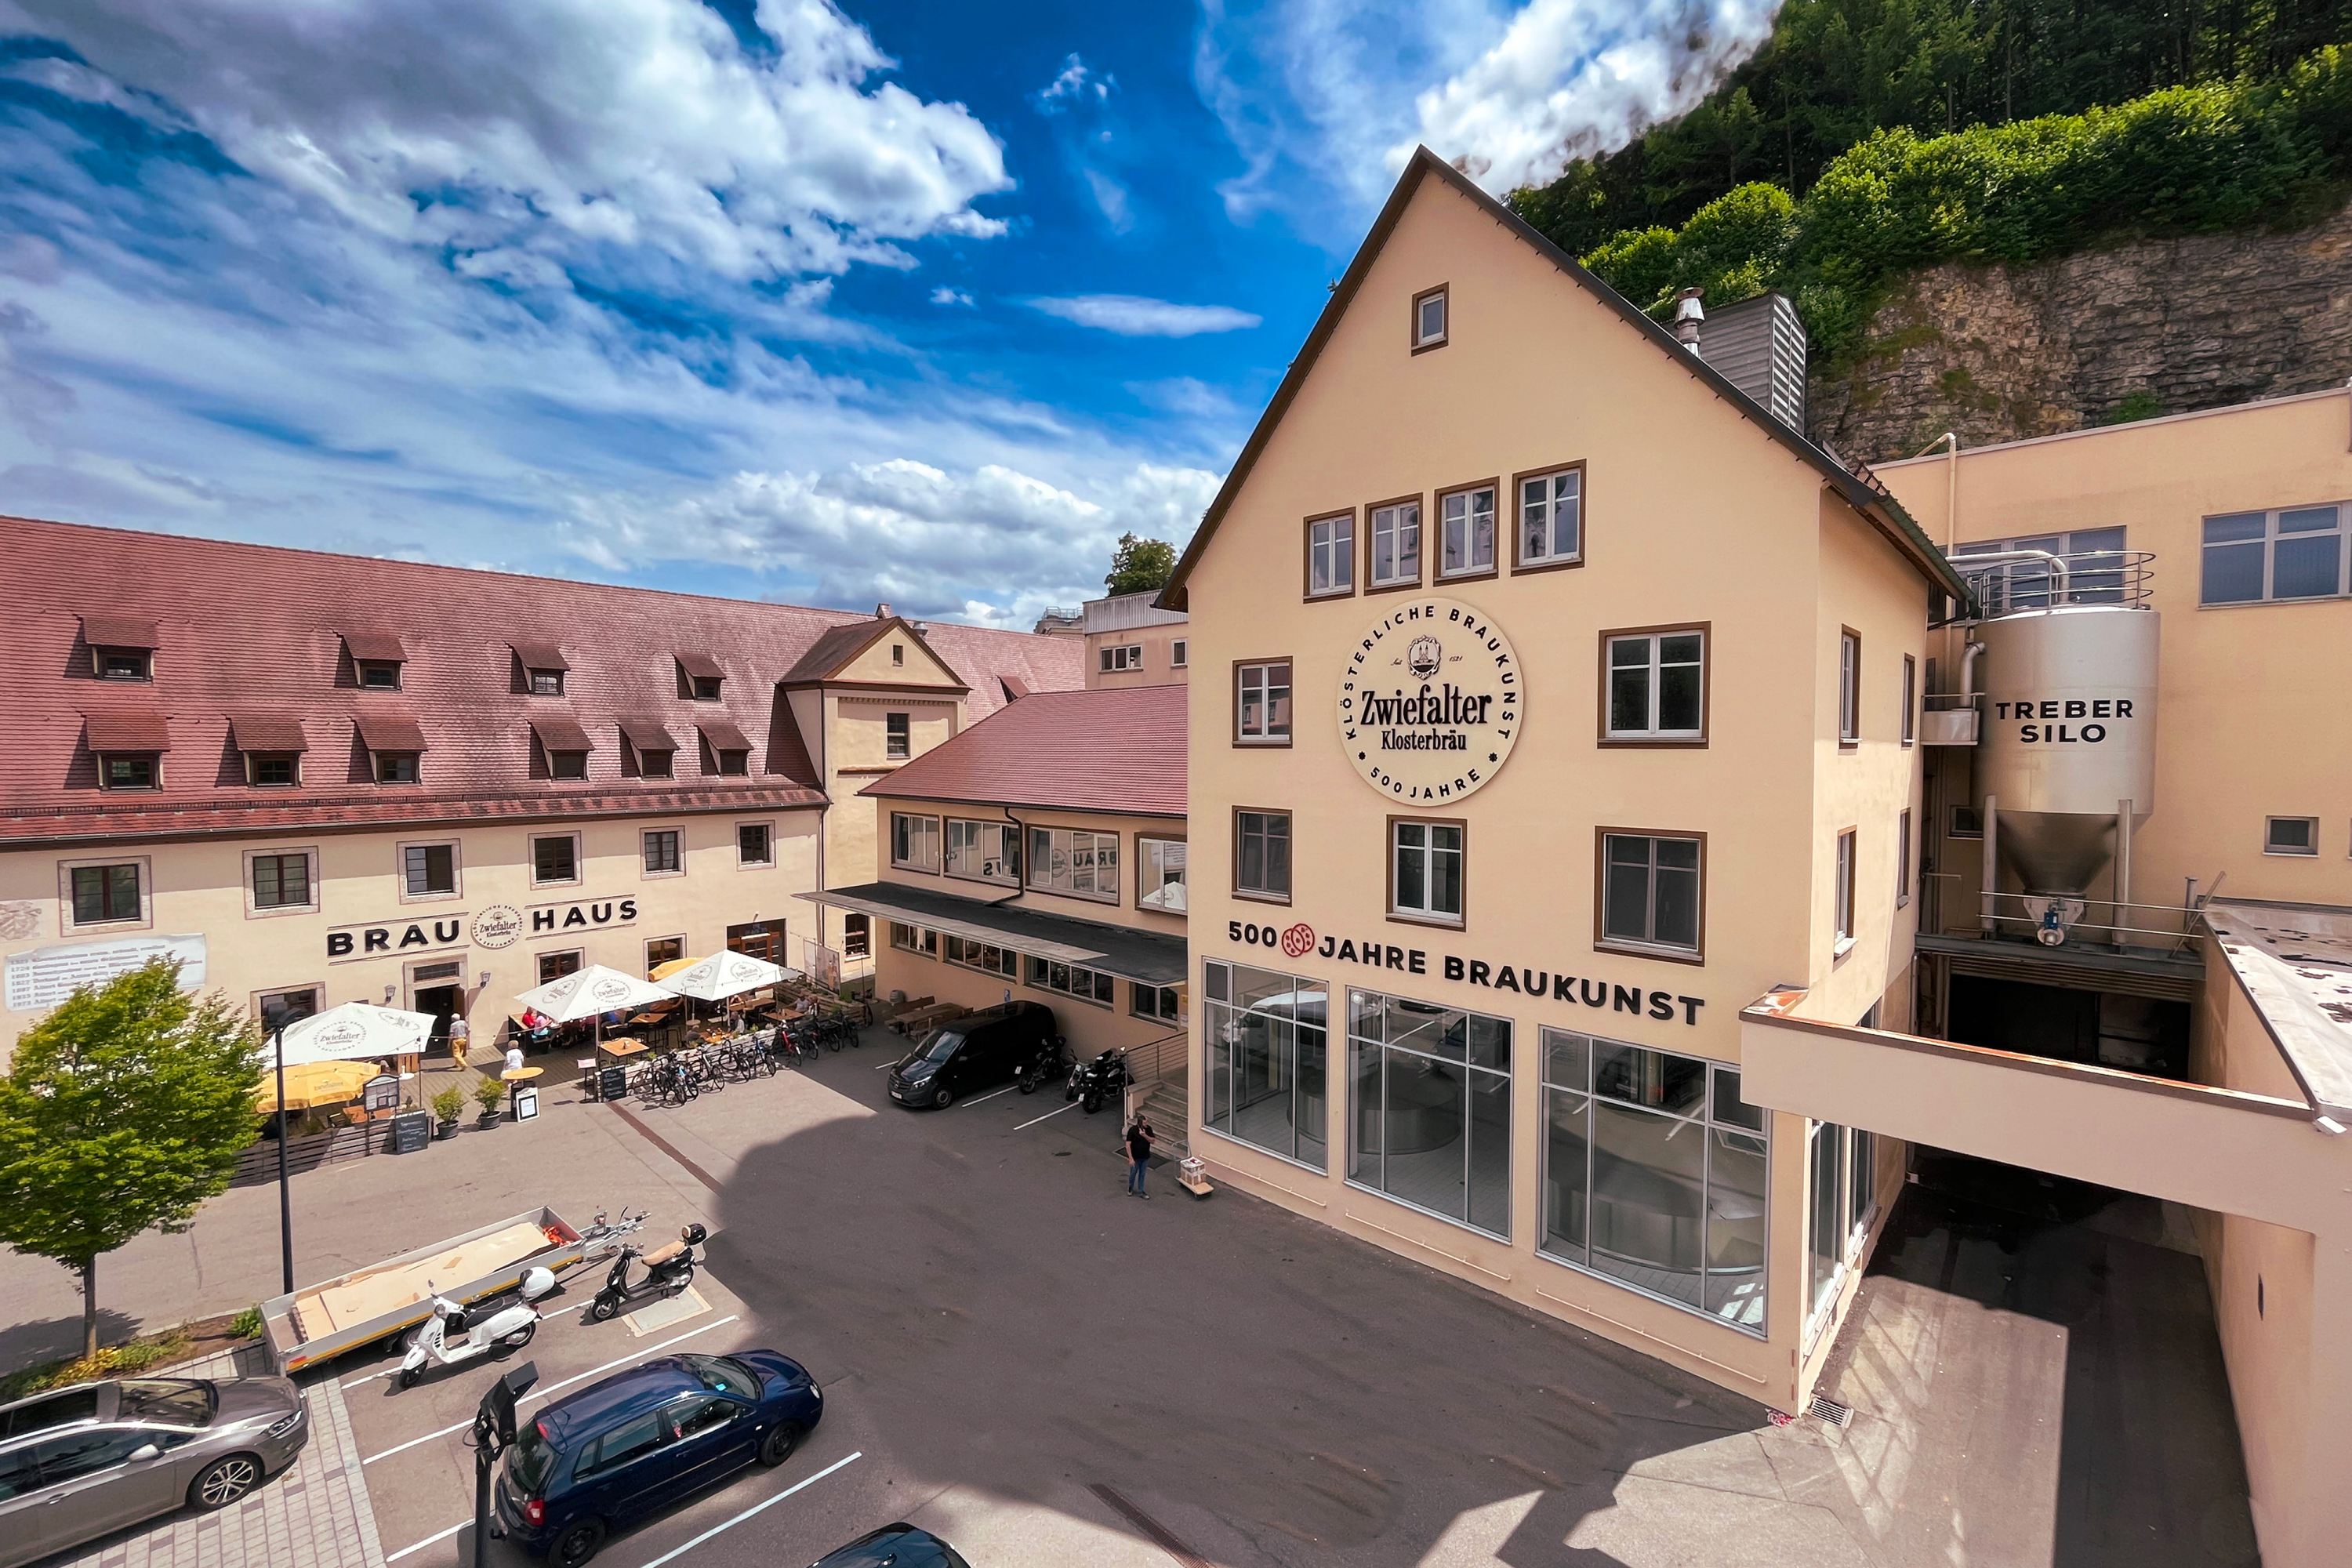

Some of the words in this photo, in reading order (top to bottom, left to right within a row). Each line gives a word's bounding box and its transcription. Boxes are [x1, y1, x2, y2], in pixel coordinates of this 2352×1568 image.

[1340, 605, 1435, 740] KLÖSTERLICHE
[1449, 608, 1516, 739] BRAUKUNST
[1360, 683, 1493, 725] Zwiefalter
[1995, 699, 2133, 720] TREBER
[1381, 728, 1467, 750] Klosterbräu
[2020, 724, 2107, 743] SILO
[1370, 766, 1403, 793] 500
[1409, 768, 1481, 800] JAHRE
[328, 920, 460, 956] BRAU
[533, 900, 637, 931] HAUS
[479, 920, 517, 934] Zwiefalter
[1229, 920, 1277, 949] 500
[1318, 935, 1427, 975] JAHRE
[1443, 955, 1706, 1027] BRAUKUNST
[320, 1032, 360, 1043] Zwiefalter
